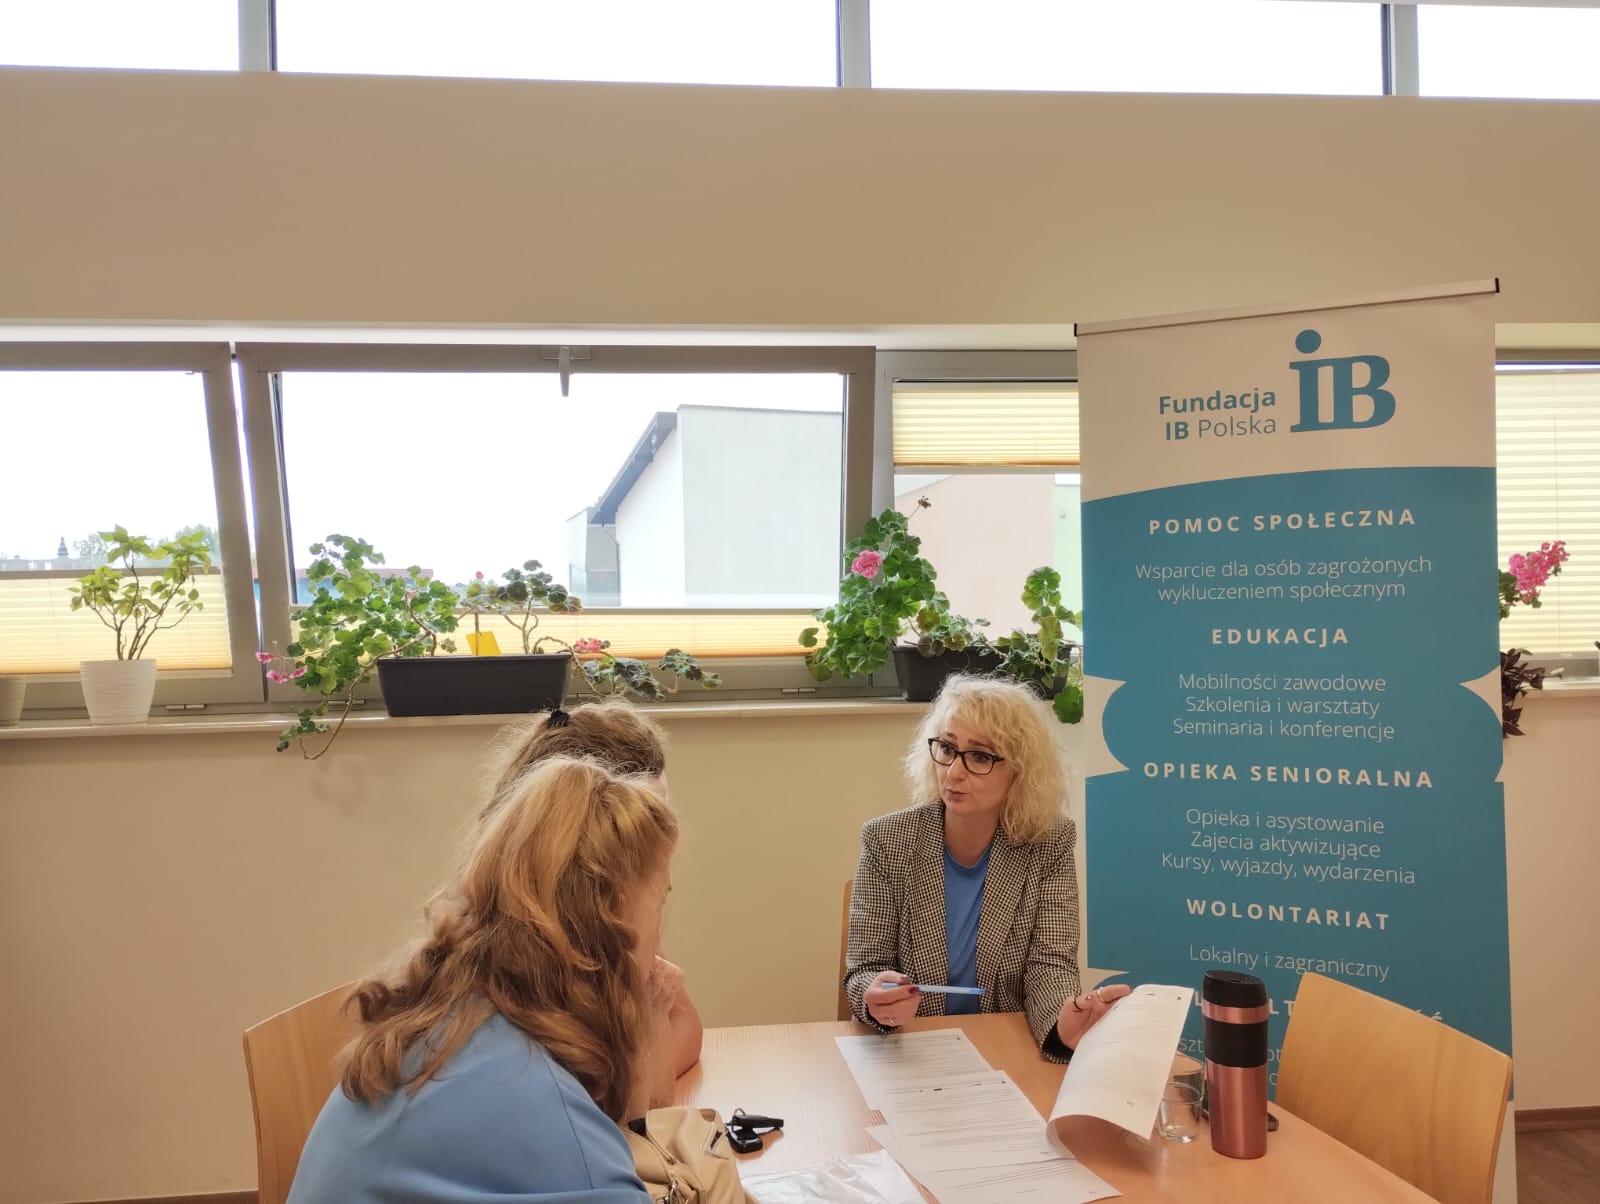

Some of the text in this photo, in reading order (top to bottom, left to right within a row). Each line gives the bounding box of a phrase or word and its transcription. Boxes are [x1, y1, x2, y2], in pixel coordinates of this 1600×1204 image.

[1159, 388, 1276, 414] Fundacja
[1165, 415, 1276, 440] IB Polska
[1149, 509, 1415, 534] POMOC SPOŁECZNA
[1135, 555, 1431, 582] Wsparcie dla osób zagrożonych
[1158, 580, 1405, 605] wykluczeniem społecznym
[1212, 628, 1348, 647] EDUKACJA
[1179, 673, 1386, 691] Mobilności zawodowe
[1186, 697, 1379, 719] Szkolenia i warsztaty
[1173, 719, 1395, 742] Seminaria i konferencje
[1144, 762, 1432, 788] OPIEKA SENIORALNA
[1186, 808, 1384, 834] Opieka i asystowanie
[1260, 834, 1380, 860] aktywizujące
[1162, 852, 1415, 884] Kursy, wyjazdy, wydarzenia
[1186, 899, 1389, 930] WOLONTARIAT
[1190, 945, 1389, 982] Lokalny i zagraniczny
